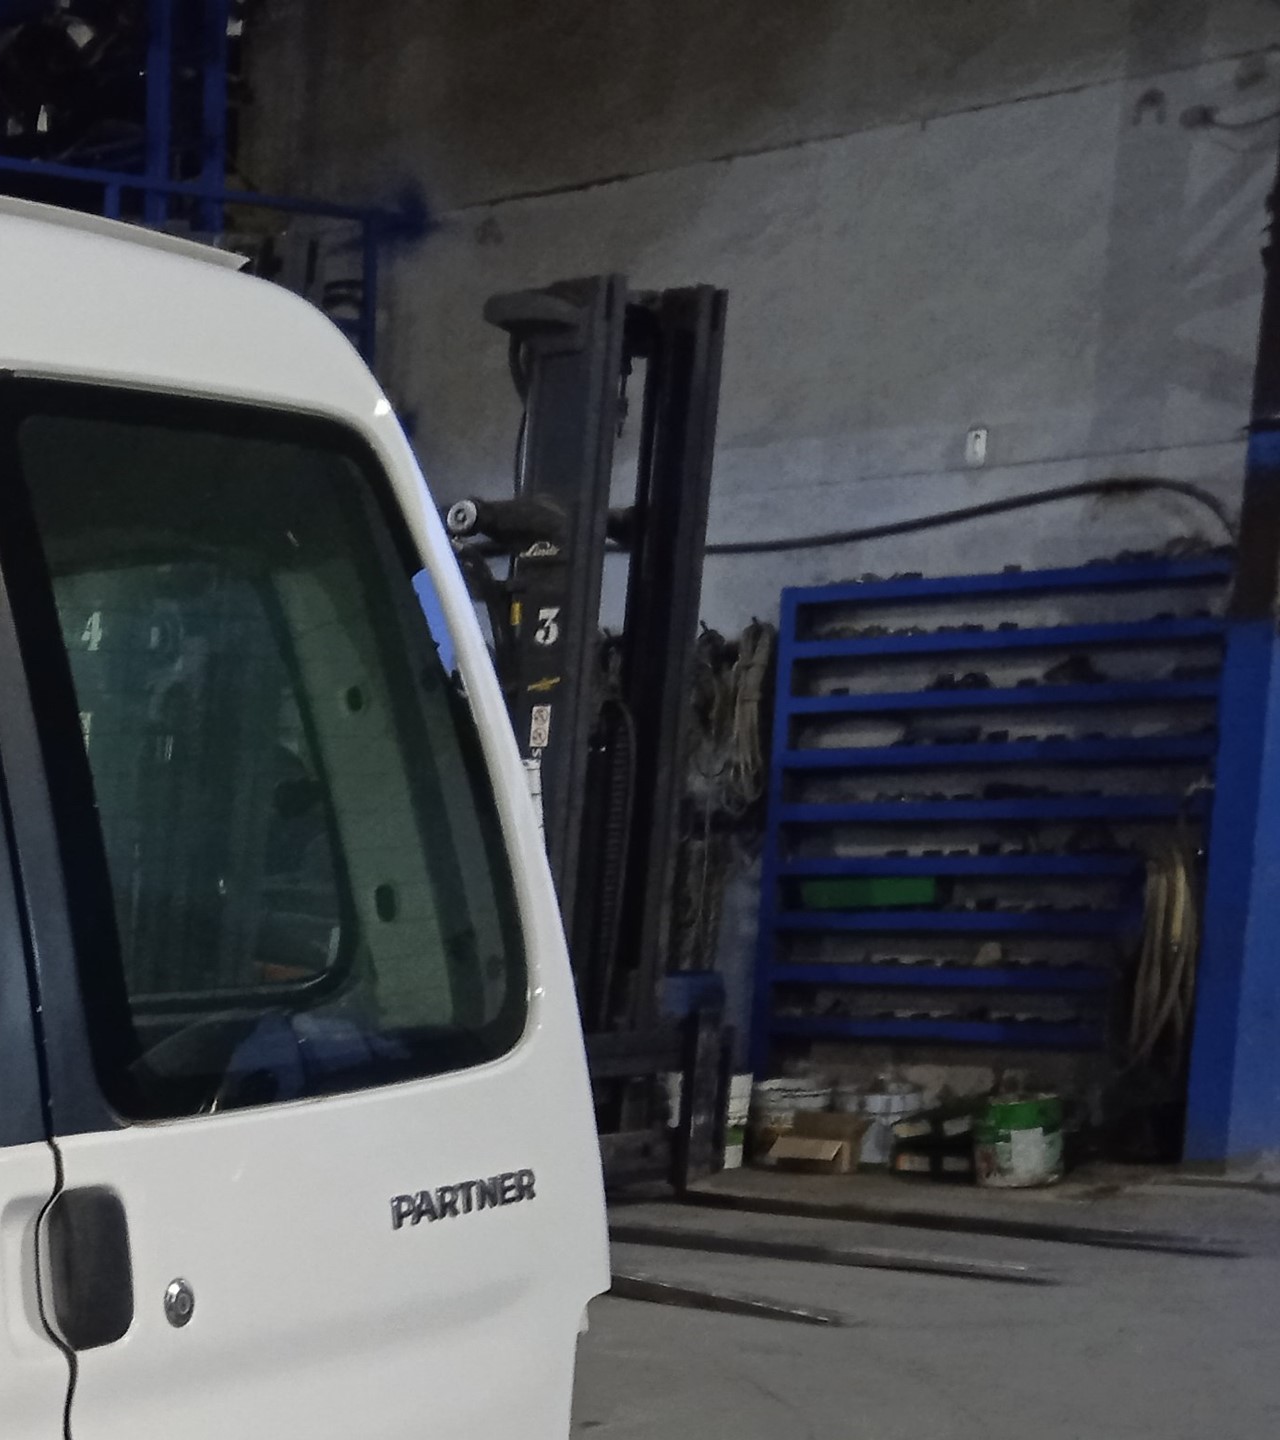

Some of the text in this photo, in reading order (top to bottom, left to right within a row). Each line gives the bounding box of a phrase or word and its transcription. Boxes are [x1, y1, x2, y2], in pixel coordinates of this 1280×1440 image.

[81, 611, 103, 651] 4
[534, 606, 560, 646] 3
[390, 1168, 536, 1230] PARTNER
